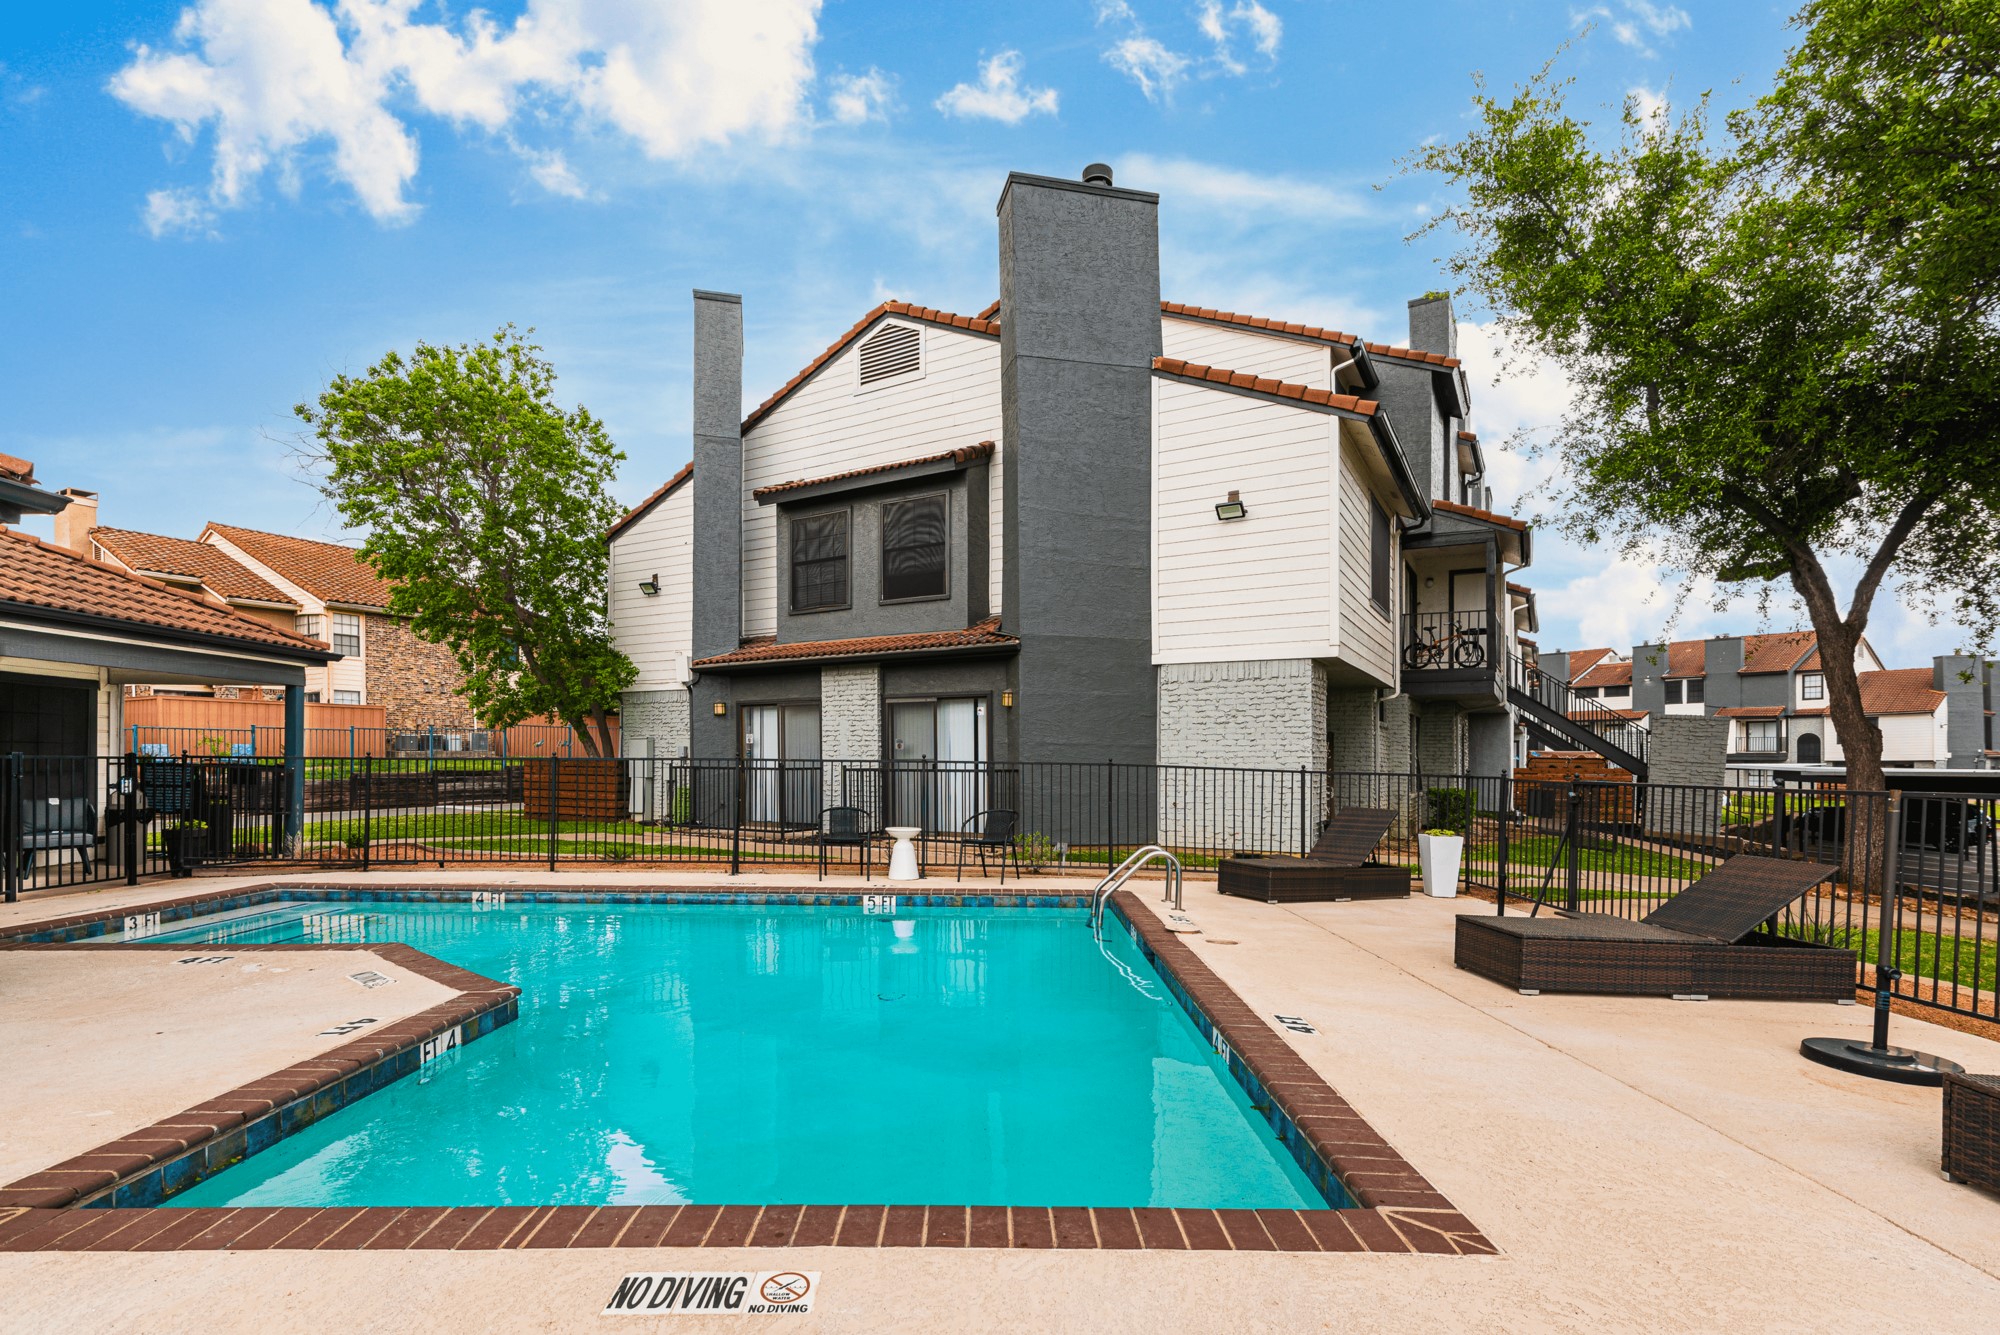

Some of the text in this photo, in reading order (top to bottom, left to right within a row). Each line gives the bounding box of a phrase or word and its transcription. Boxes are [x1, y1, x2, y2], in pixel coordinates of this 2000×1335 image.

[476, 891, 503, 902] 4 FT
[867, 895, 894, 907] 5 FT
[129, 912, 158, 930] 3 FT
[423, 1029, 457, 1065] FT 4
[606, 1276, 748, 1310] NO DIVING
[748, 1304, 808, 1314] NO DIVING
